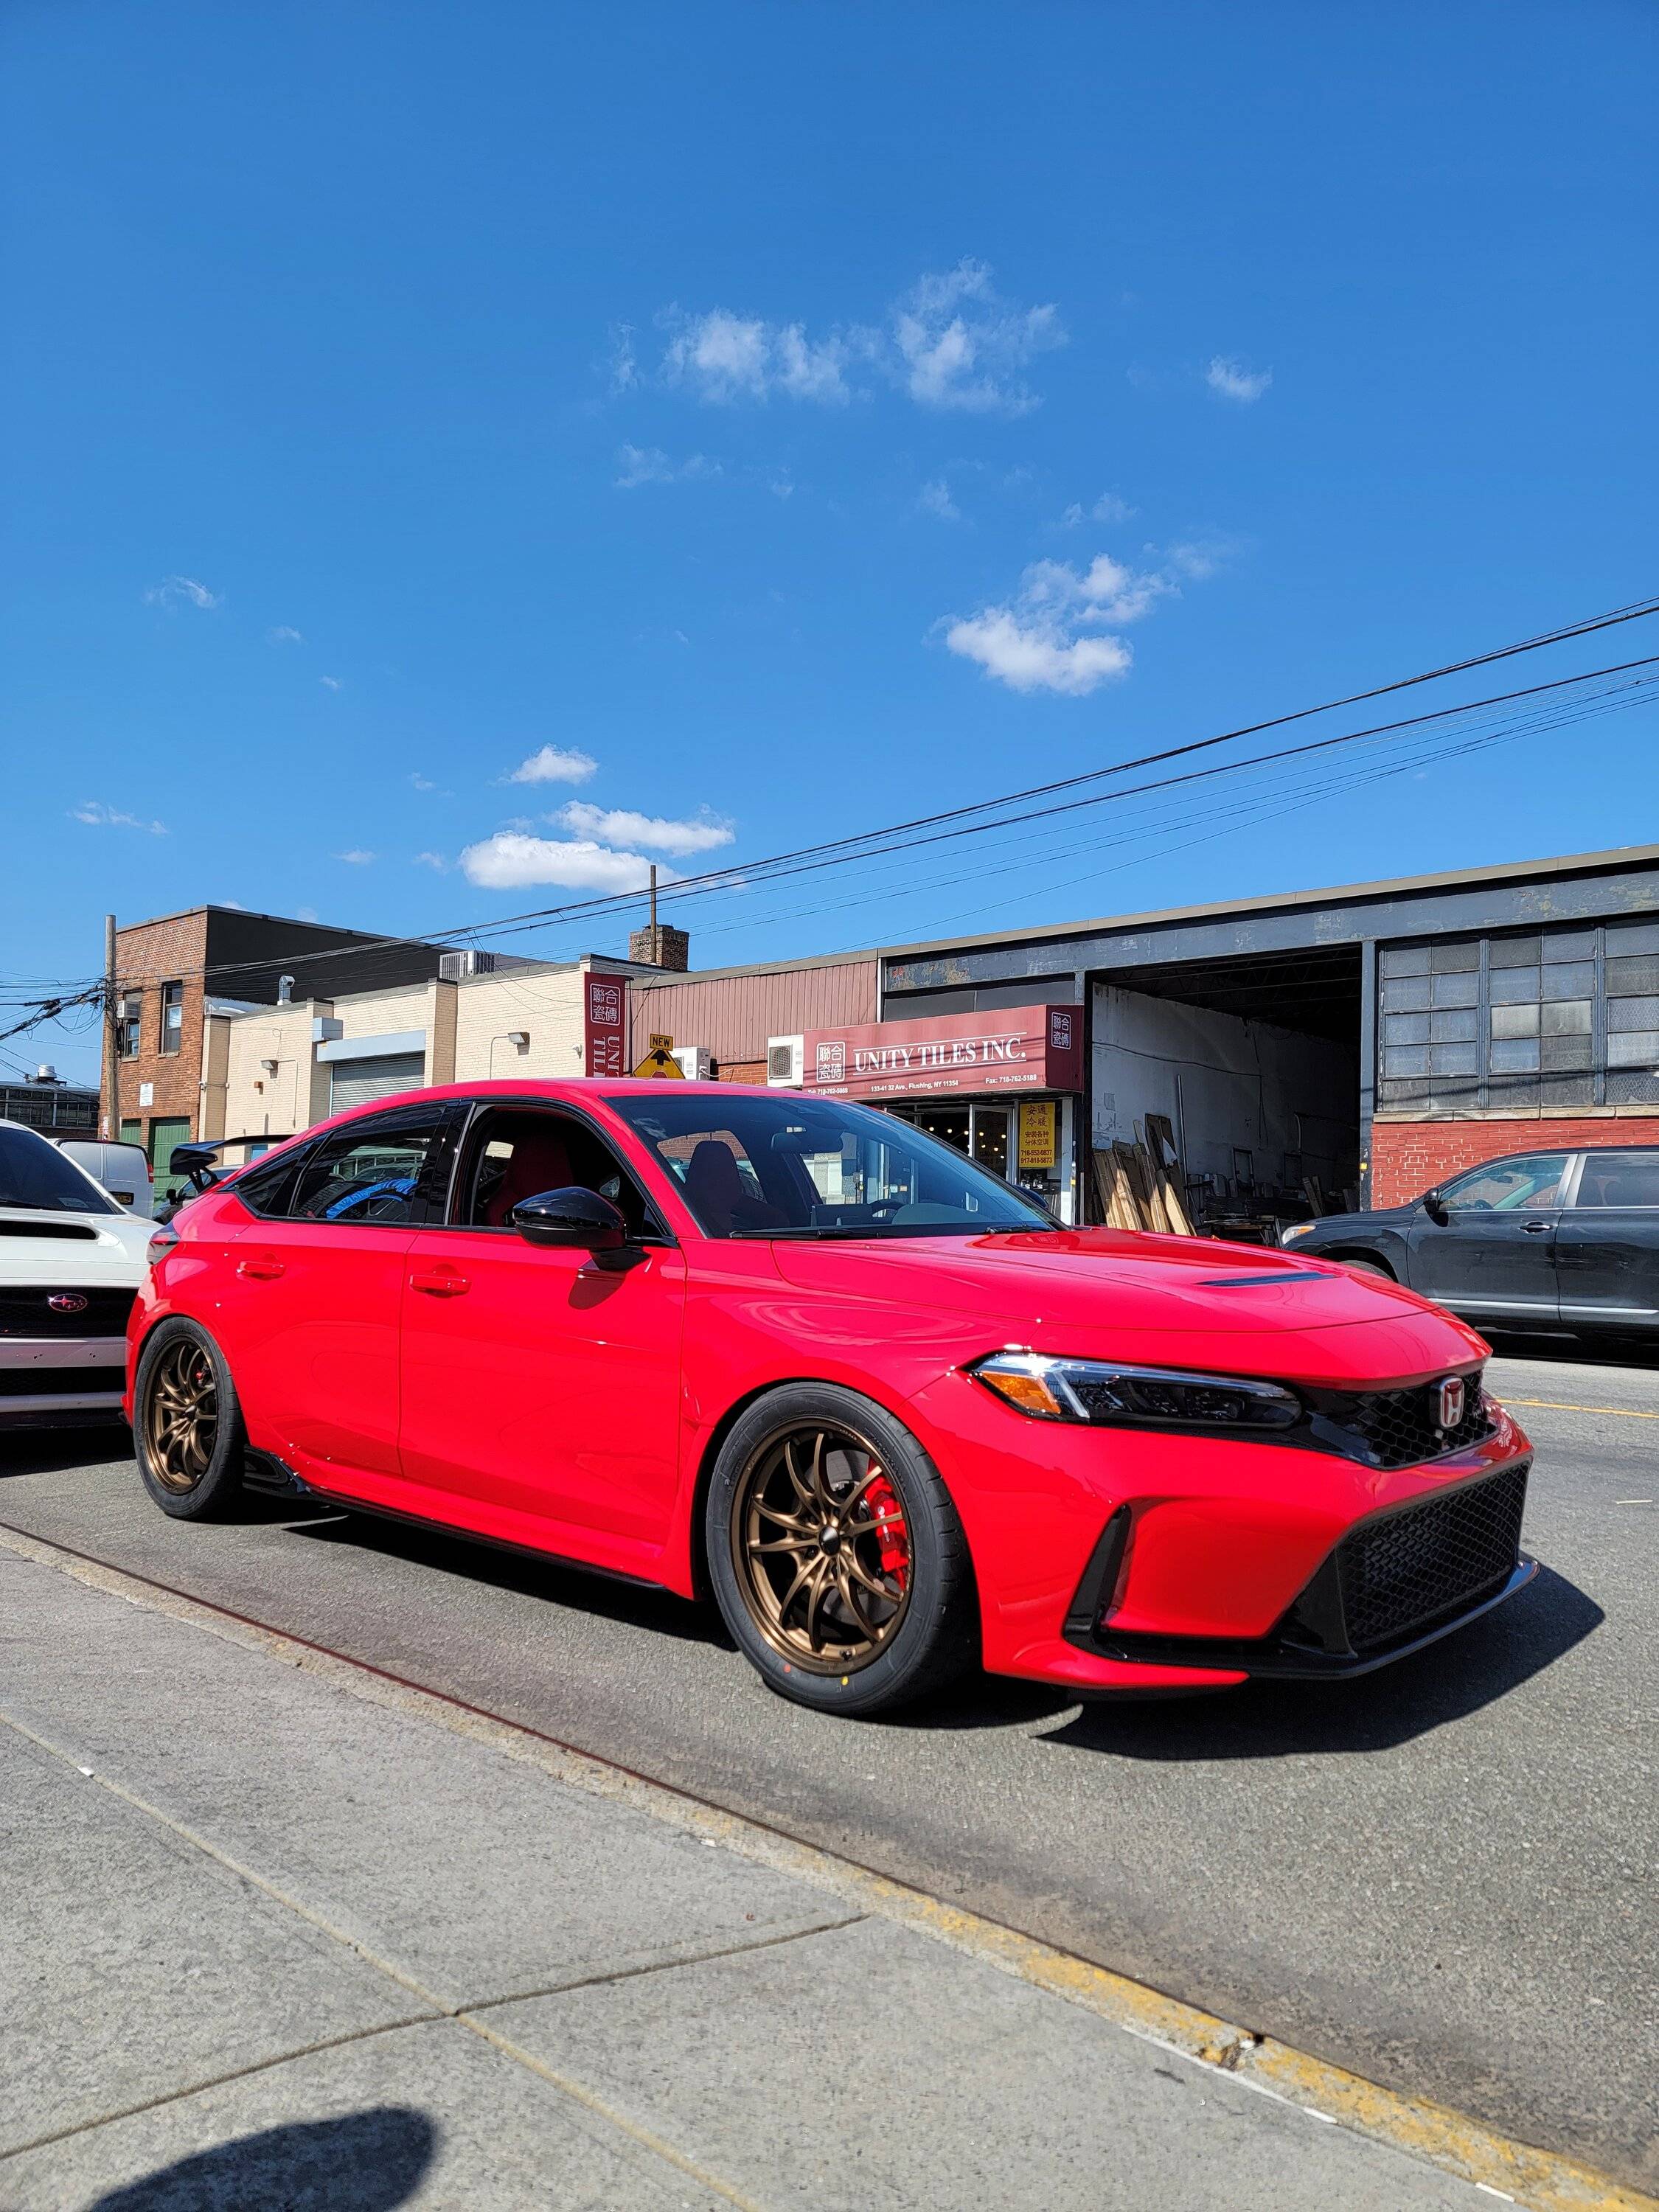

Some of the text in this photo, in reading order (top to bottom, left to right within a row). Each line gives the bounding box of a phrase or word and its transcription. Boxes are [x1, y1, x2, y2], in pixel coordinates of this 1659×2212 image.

[592, 987, 618, 1005] 聯合
[592, 1004, 618, 1022] 瓷磚
[653, 1037, 670, 1048] NEW
[818, 1045, 843, 1062] 聯合
[854, 1037, 1026, 1072] UNITY TILES INC.
[818, 1062, 843, 1079] 瓷磚
[999, 1074, 1037, 1082] 718-762-5188
